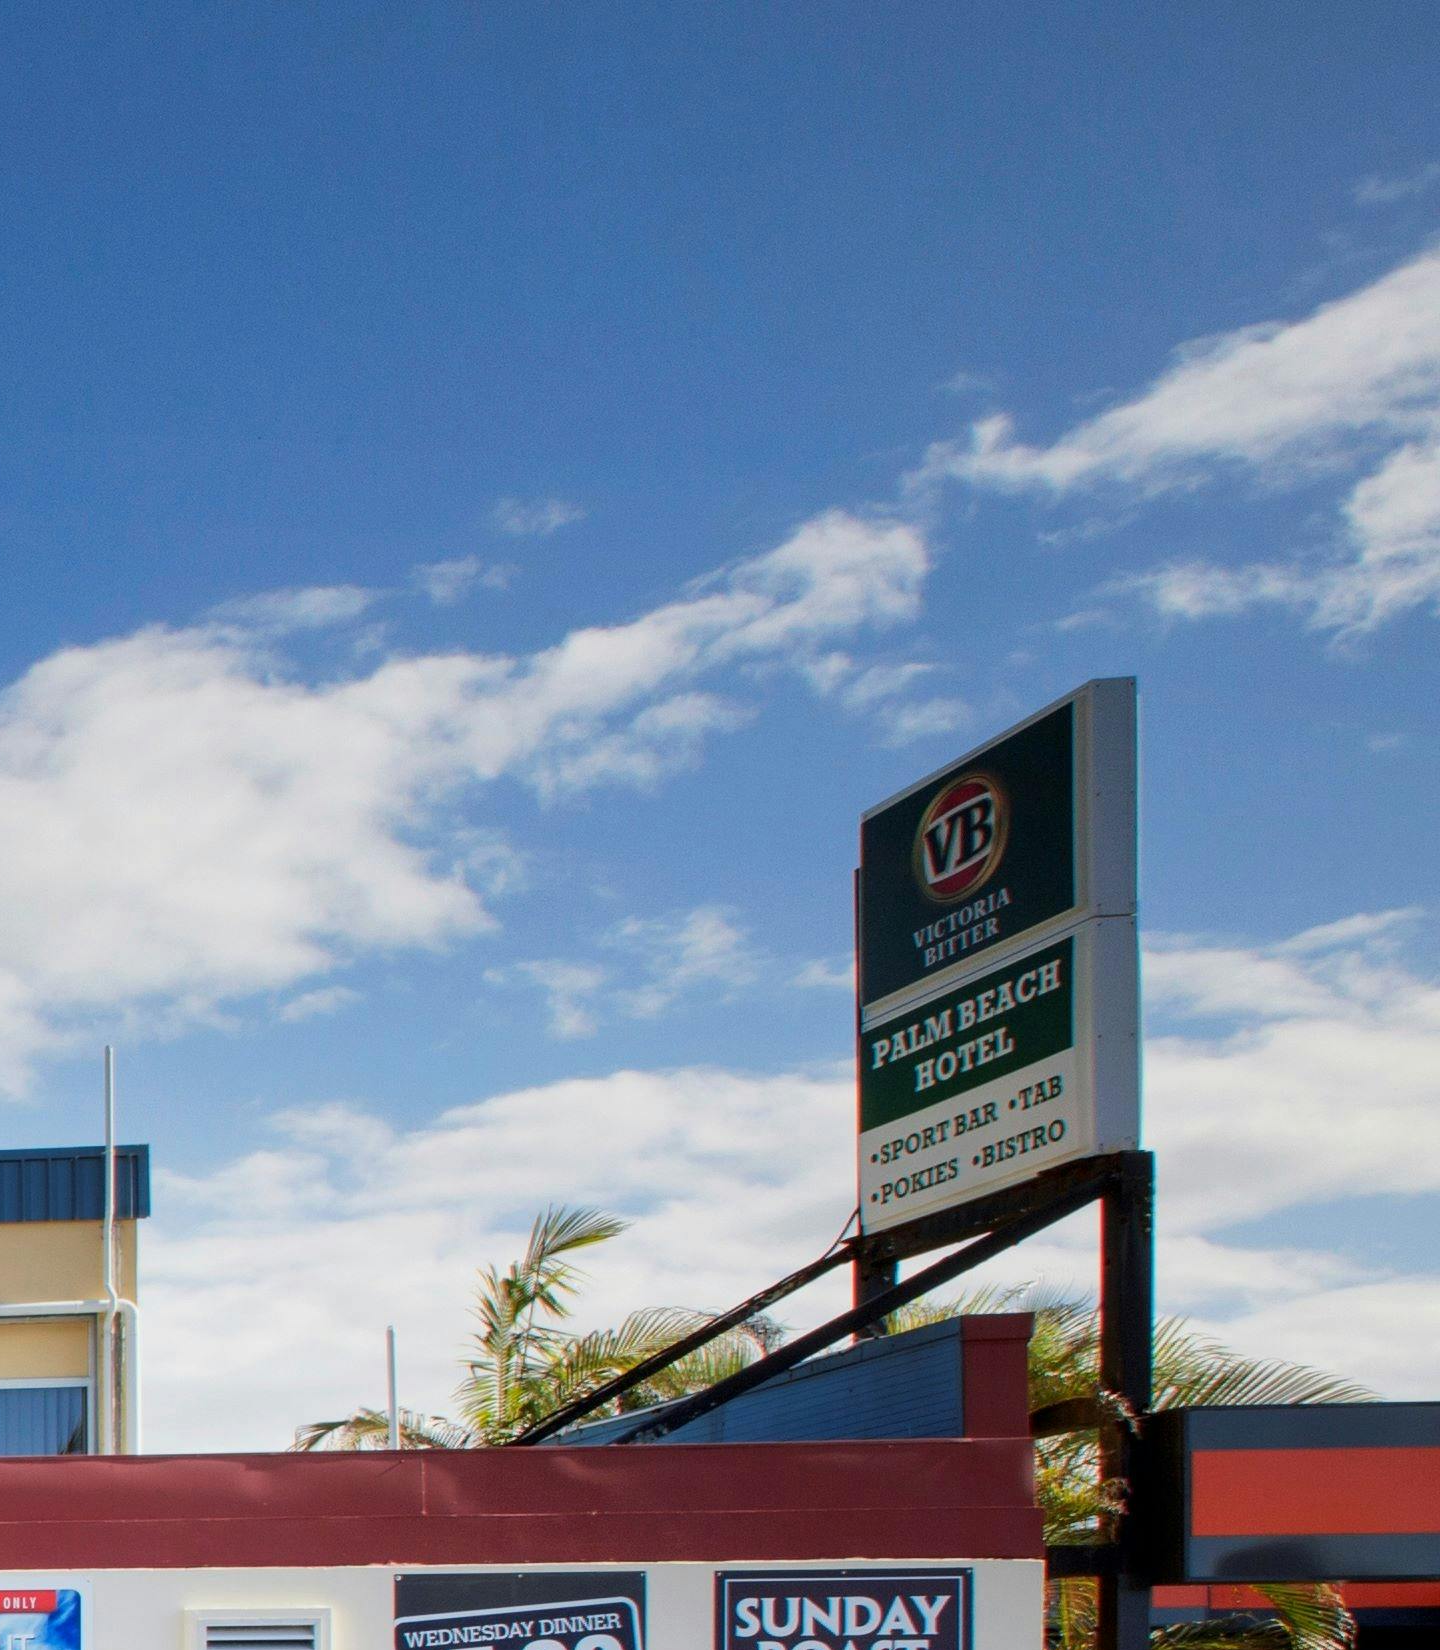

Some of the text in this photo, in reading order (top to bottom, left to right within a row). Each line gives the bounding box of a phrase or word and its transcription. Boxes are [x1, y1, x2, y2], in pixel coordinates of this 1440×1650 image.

[923, 798, 993, 875] VB
[912, 888, 1011, 949] VICTORIA
[924, 917, 1000, 968] BITTER
[872, 958, 1062, 1070] PALM BEACH
[914, 1027, 1015, 1093] HOTEL
[953, 1100, 998, 1141] BAR
[3, 1596, 37, 1610] ONLY
[735, 1595, 952, 1638] SUNDAY
[404, 1613, 622, 1648] WEDNESDAY DINNER
